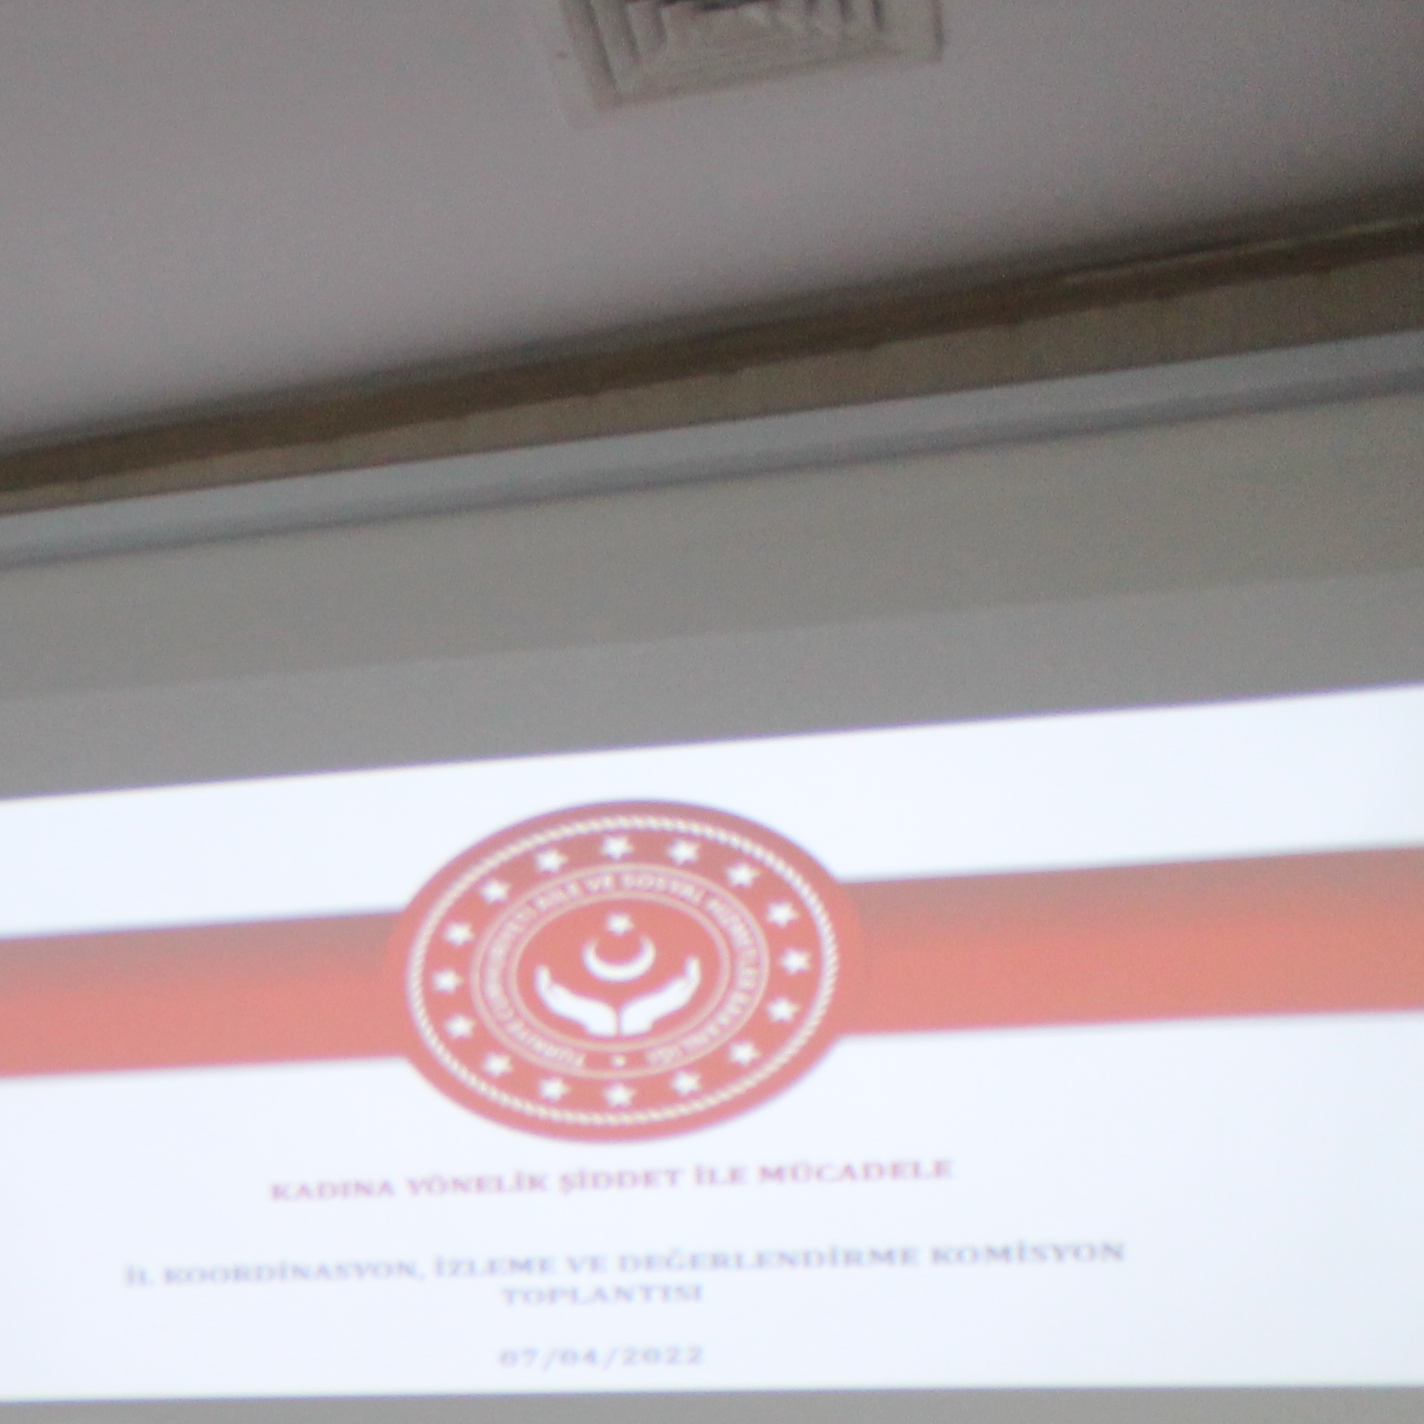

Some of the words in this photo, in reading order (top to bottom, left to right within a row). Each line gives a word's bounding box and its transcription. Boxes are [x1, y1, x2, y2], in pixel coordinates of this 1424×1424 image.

[268, 1178, 396, 1203] KADINA
[405, 1169, 549, 1197] YÖNELİK
[557, 1166, 683, 1196] ŞİDDET
[692, 1163, 747, 1188] İLE
[756, 1158, 952, 1185] MÜCADELE
[433, 1255, 554, 1278] İZLEME
[564, 1253, 606, 1275] VE
[616, 1245, 919, 1274] DEĞERLENDİRME
[929, 1239, 1126, 1267] KOMİSYON
[500, 1282, 704, 1307] TOPLANTISI
[496, 1343, 704, 1372] 07/04/2022
